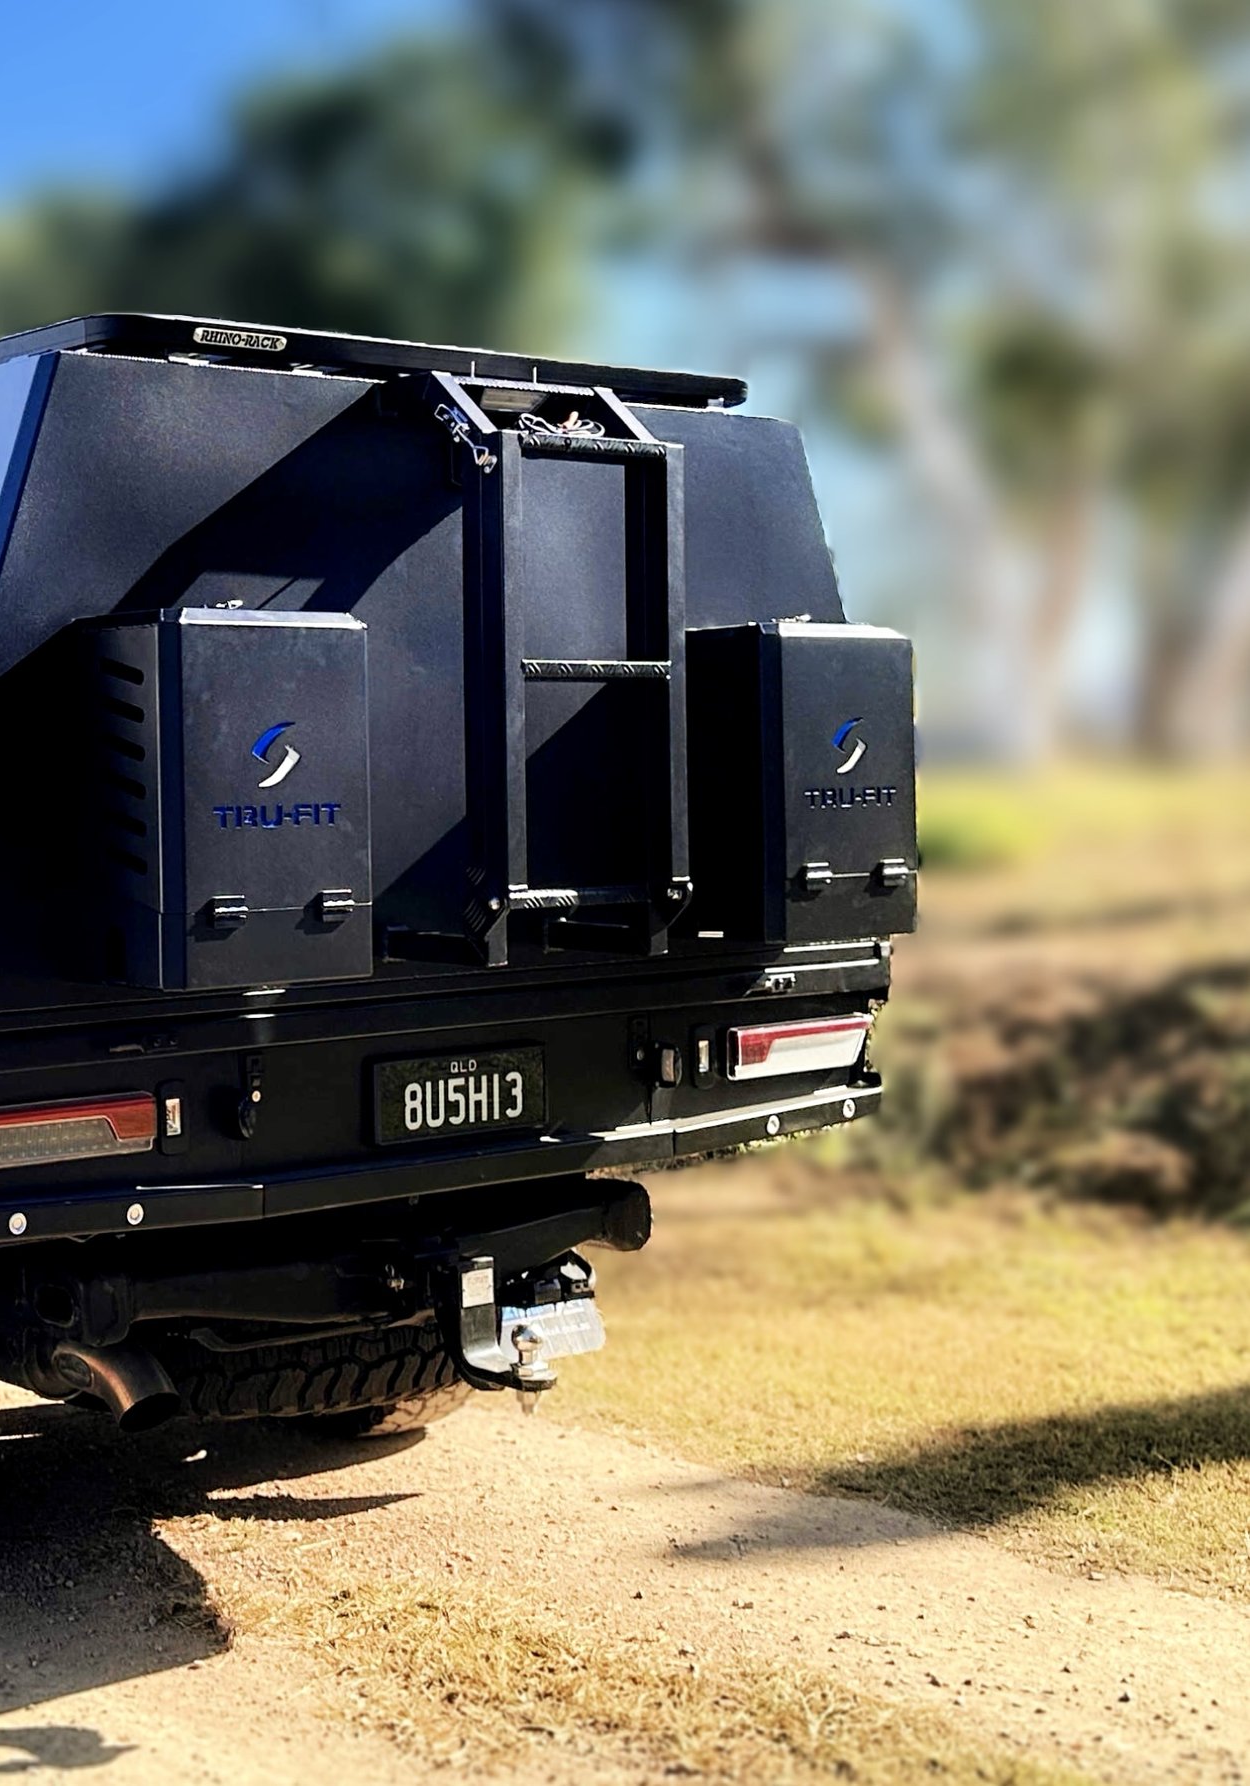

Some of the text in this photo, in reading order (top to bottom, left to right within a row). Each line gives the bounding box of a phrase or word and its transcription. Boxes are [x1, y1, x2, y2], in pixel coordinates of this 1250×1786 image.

[200, 328, 282, 350] RHINO-RACK
[803, 787, 897, 809] TRU-FIT
[212, 803, 342, 830] TRU-FIT
[450, 1059, 478, 1074] QLD
